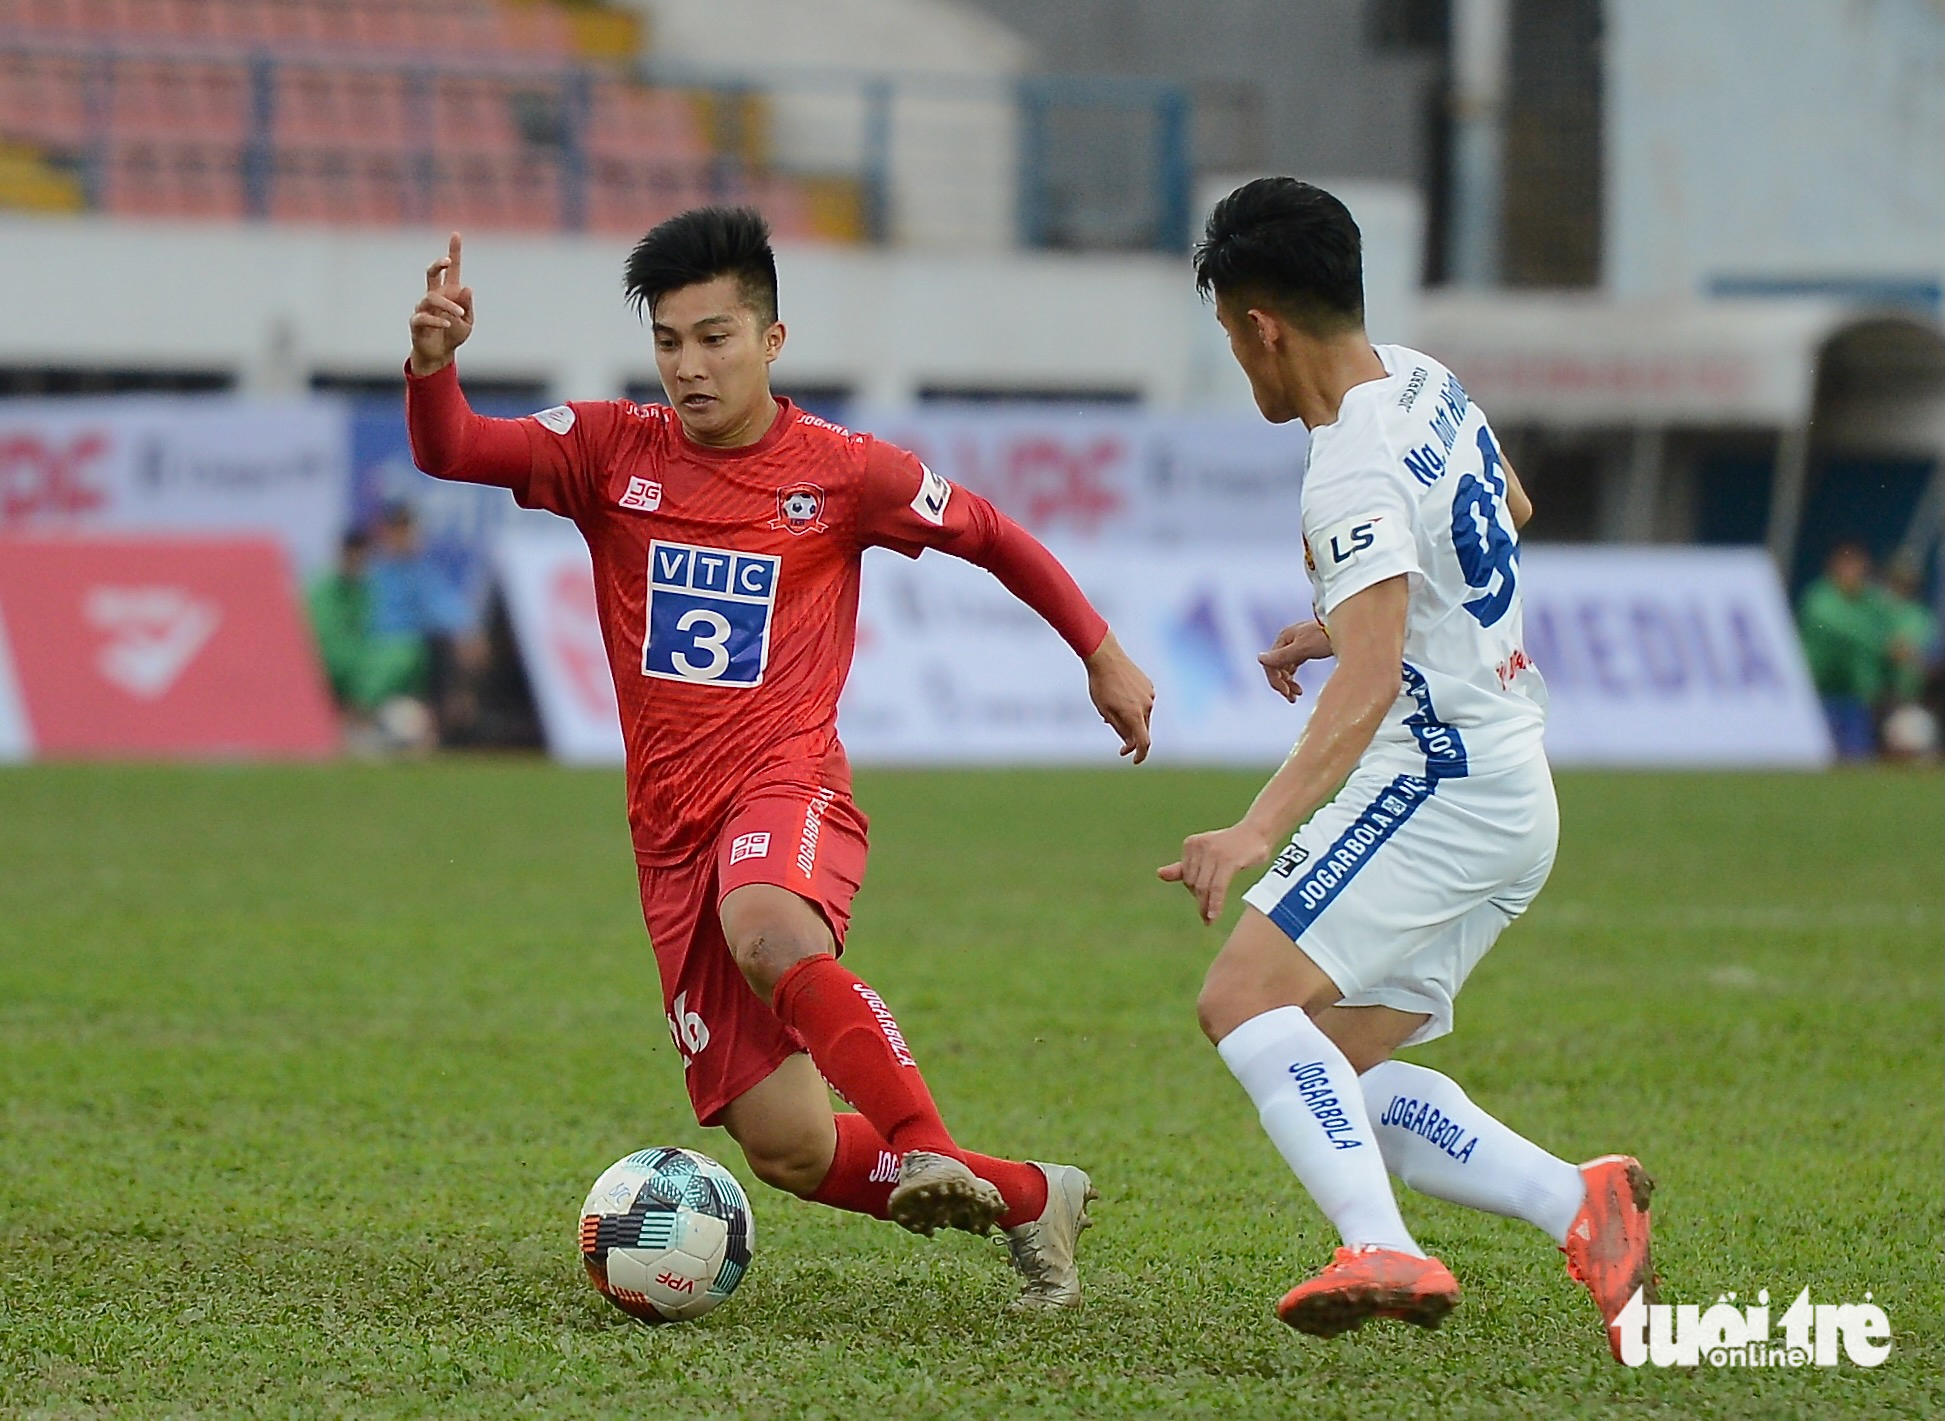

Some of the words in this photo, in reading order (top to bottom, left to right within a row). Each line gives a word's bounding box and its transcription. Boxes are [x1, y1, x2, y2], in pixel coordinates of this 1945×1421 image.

[659, 551, 766, 592] VTC
[1330, 523, 1374, 563] LS
[671, 609, 732, 680] 3
[1298, 812, 1393, 910] JOGARBOLA
[852, 983, 917, 1068] JOGARBOLA
[1289, 1061, 1363, 1150] JOGARBOLA
[1381, 1095, 1478, 1164] JOGARBOLA
[655, 1272, 695, 1295] VPF
